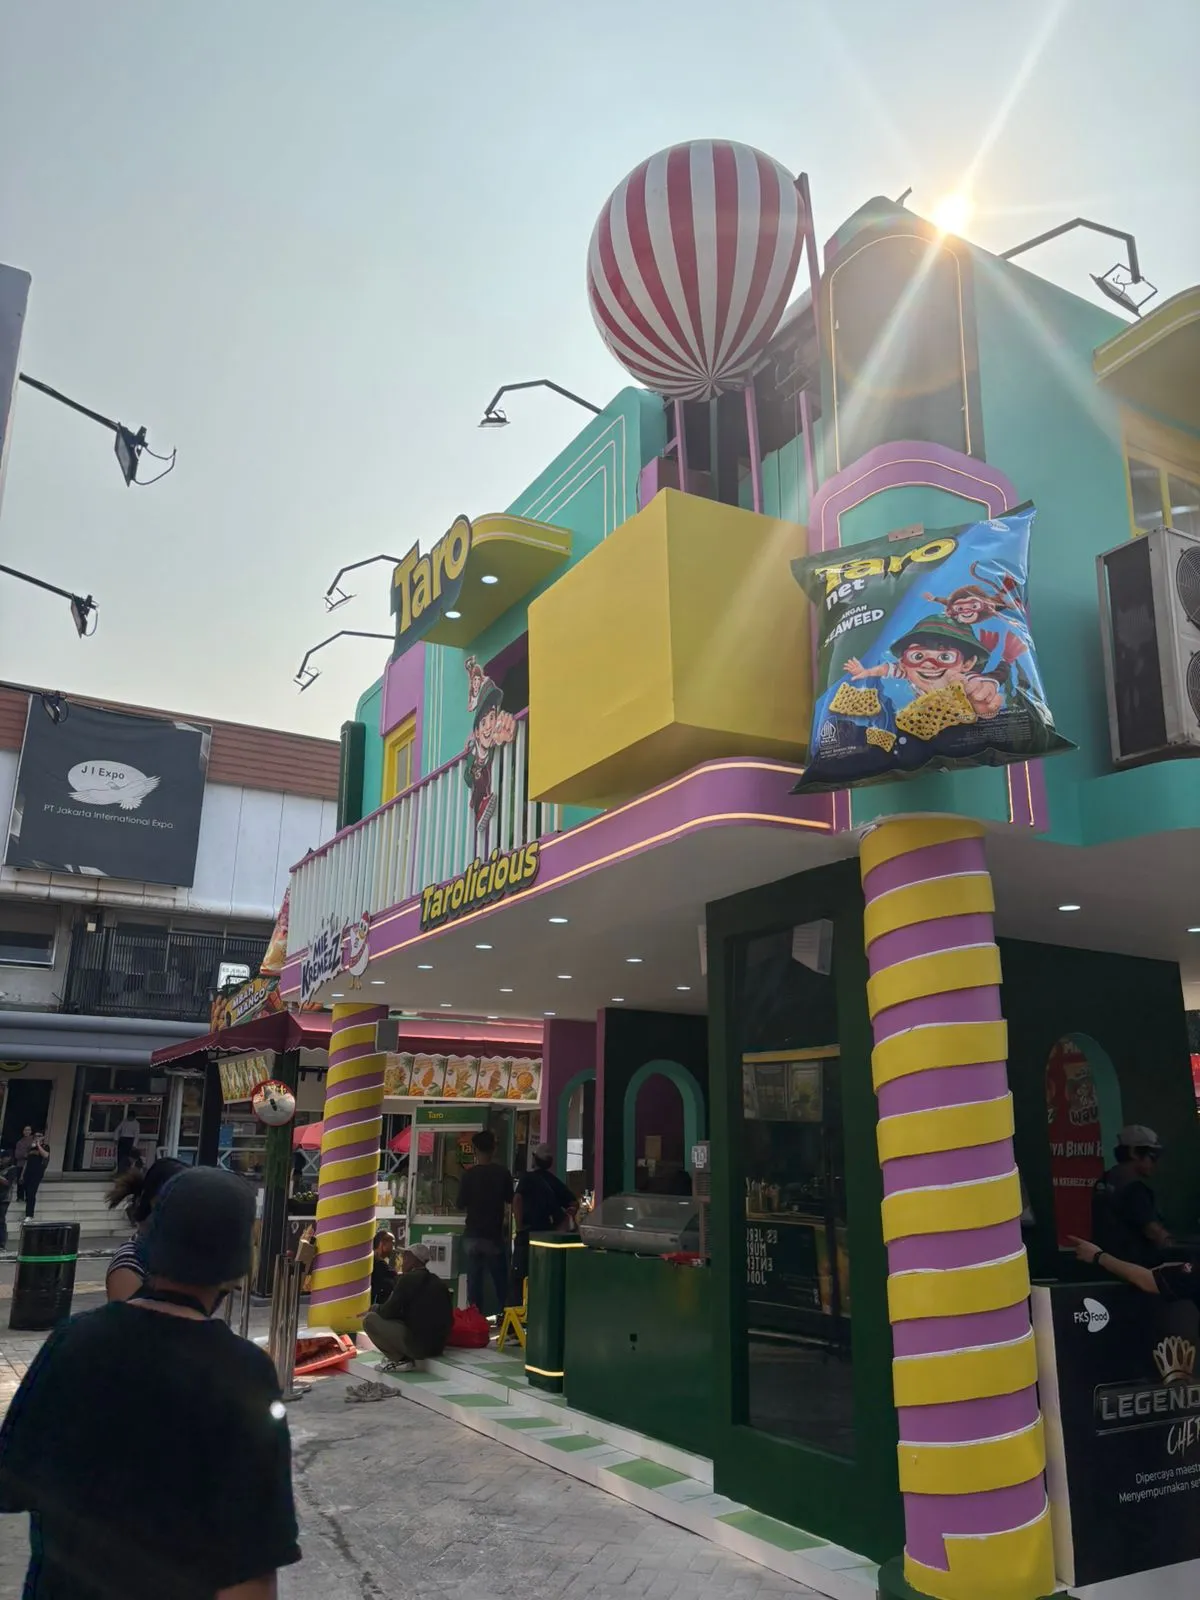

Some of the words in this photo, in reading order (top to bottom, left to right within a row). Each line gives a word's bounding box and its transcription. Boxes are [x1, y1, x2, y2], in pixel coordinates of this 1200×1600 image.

[391, 514, 471, 635] Taro
[814, 537, 957, 594] Taro
[825, 578, 865, 611] net
[81, 765, 88, 774] J
[98, 767, 125, 780] Expo
[43, 804, 54, 813] PT
[56, 806, 92, 819] Jakarta
[93, 811, 150, 826] International
[151, 819, 174, 830] Expo
[420, 841, 541, 928] Tarolicious
[312, 930, 329, 962] MIE
[301, 932, 341, 998] KREMEZZ
[1066, 1140, 1095, 1157] BIKIN
[1073, 1311, 1090, 1324] FKS
[1090, 1311, 1108, 1322] Food
[1135, 1468, 1174, 1485] Dipercaya
[1118, 1482, 1190, 1504] Menyempurnakan
